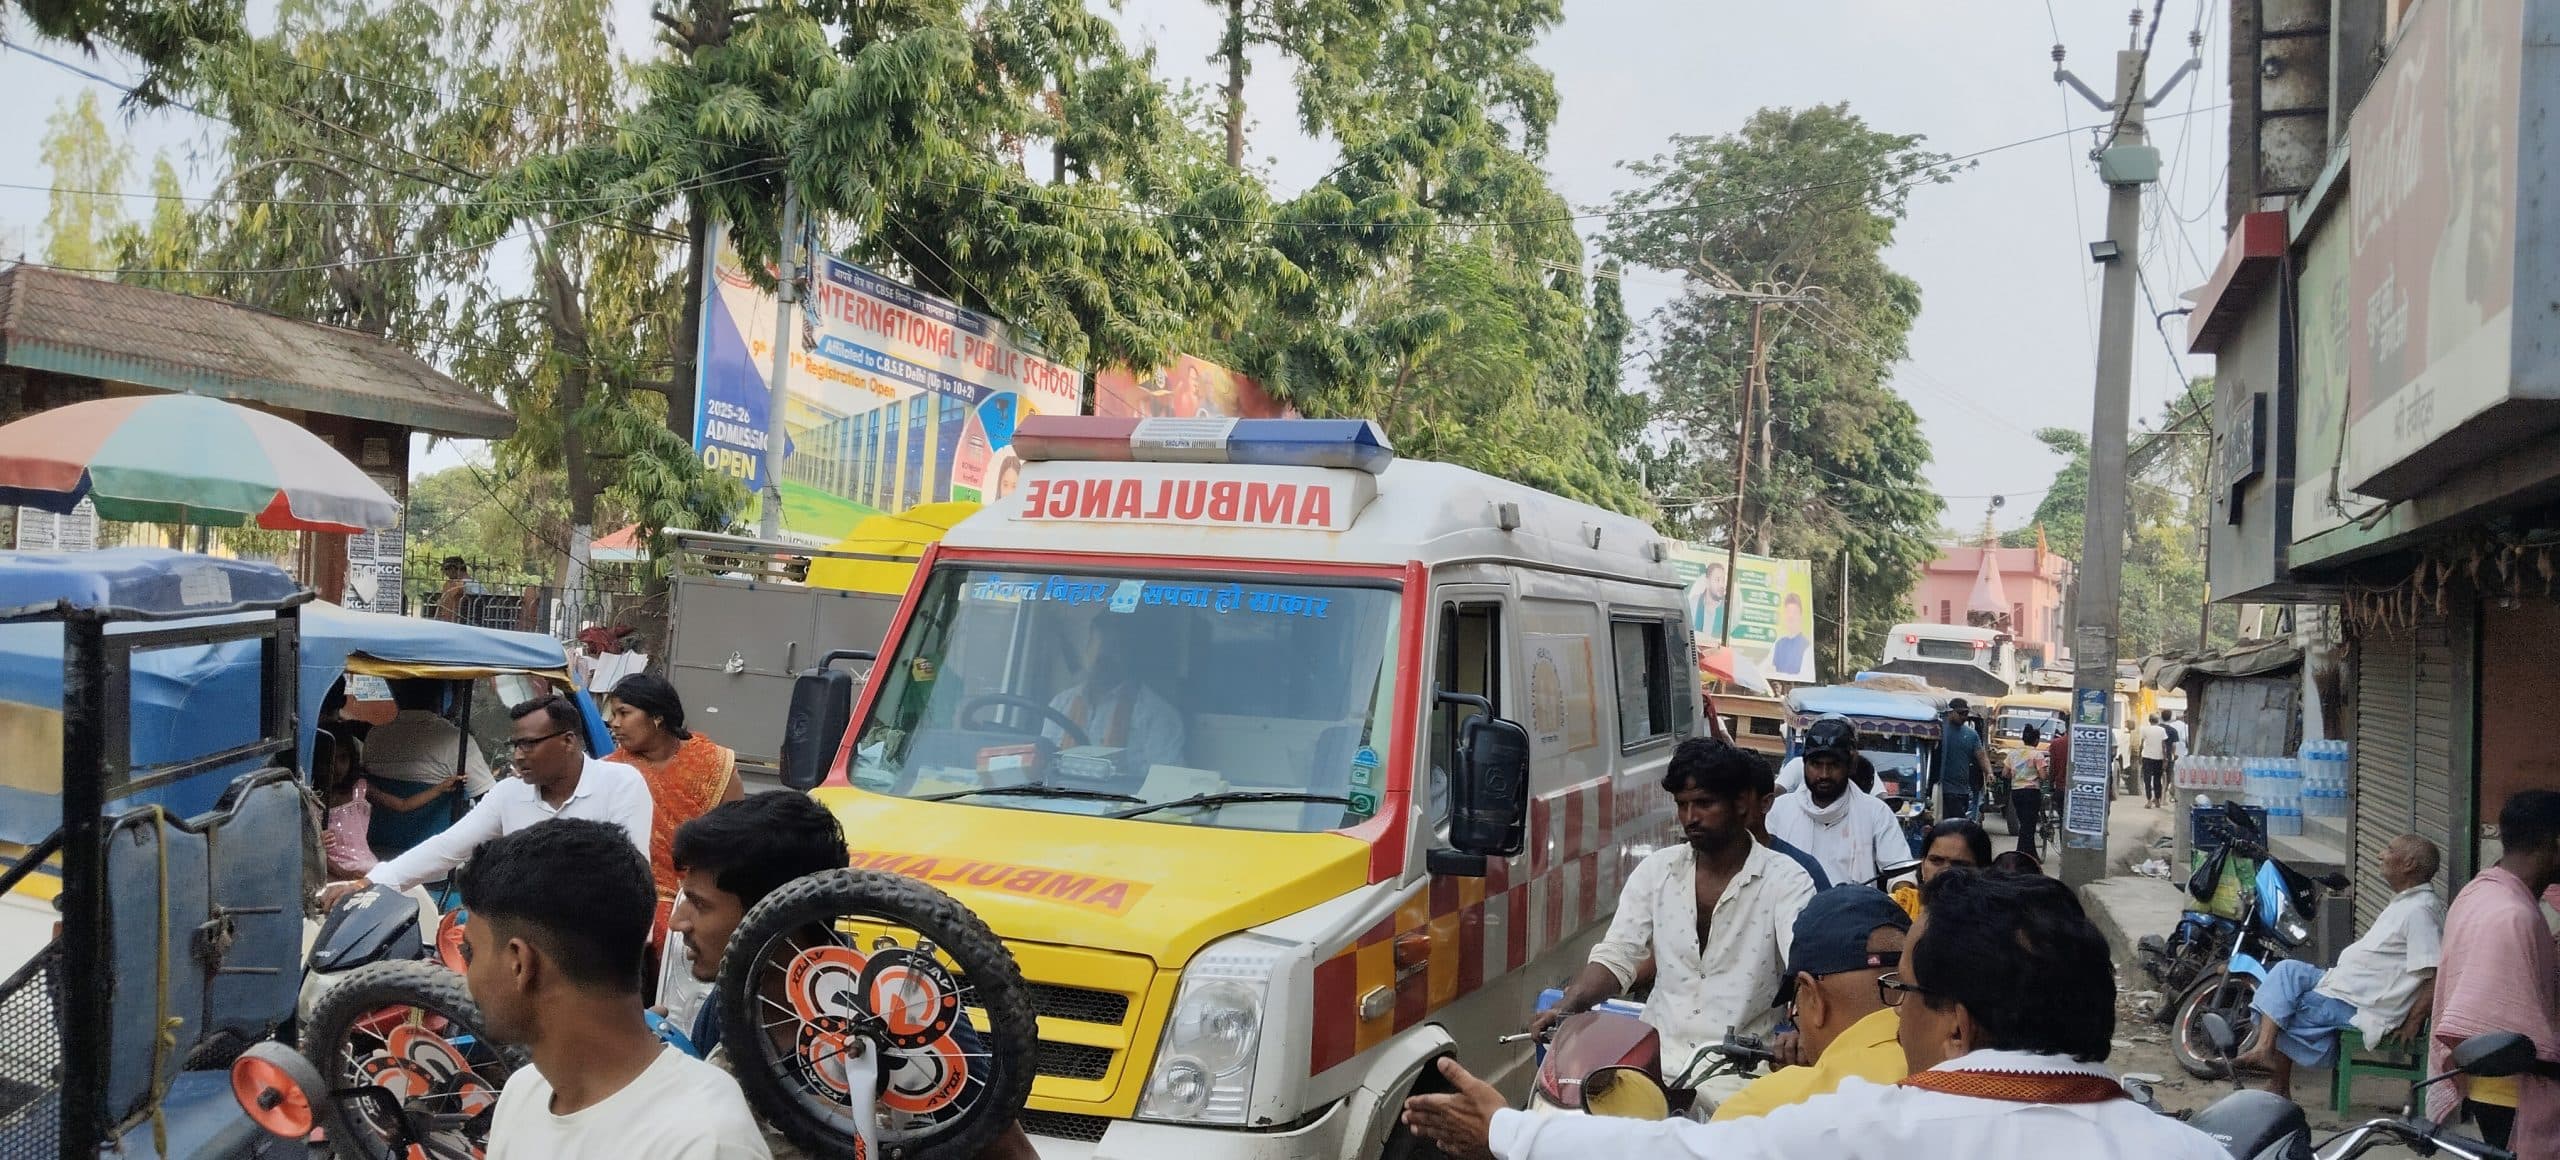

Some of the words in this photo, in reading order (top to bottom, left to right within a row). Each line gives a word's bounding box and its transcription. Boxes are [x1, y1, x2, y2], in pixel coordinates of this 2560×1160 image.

[875, 283, 895, 300] CBSE
[818, 283, 958, 360] NTERNATIONAL
[963, 336, 1019, 382] PUBLIC
[1022, 357, 1076, 401] SCHOOL
[805, 356, 867, 390] Registration
[870, 377, 896, 399] Open
[865, 352, 874, 367] to
[905, 364, 926, 384] Delhi
[927, 372, 941, 392] (Up
[943, 378, 952, 392] to
[953, 380, 976, 402] 10+2)
[708, 399, 751, 424] 2025-26
[703, 445, 756, 481] OPEN
[377, 564, 401, 575] KCC
[1143, 585, 1213, 608] सपना
[1214, 582, 1245, 614] हो
[1248, 590, 1332, 620] साकार
[2073, 730, 2106, 740] KCC
